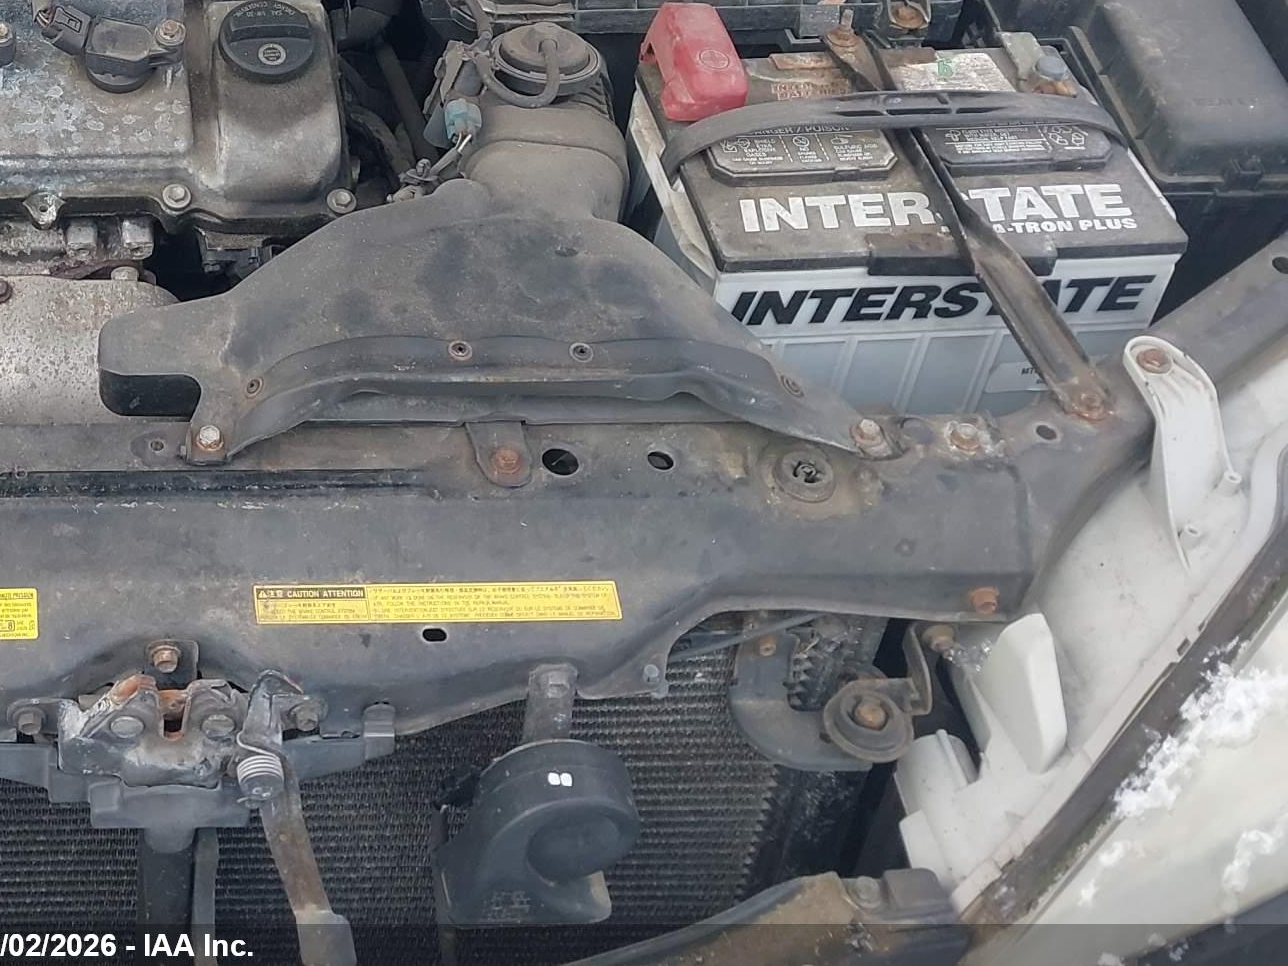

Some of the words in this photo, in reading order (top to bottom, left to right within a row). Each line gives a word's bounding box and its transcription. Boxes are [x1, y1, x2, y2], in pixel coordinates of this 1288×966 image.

[739, 183, 1133, 233] INTERTATE
[1079, 217, 1137, 231] PLUS
[286, 590, 320, 598] CAUTION
[323, 589, 364, 598] ATTENTION
